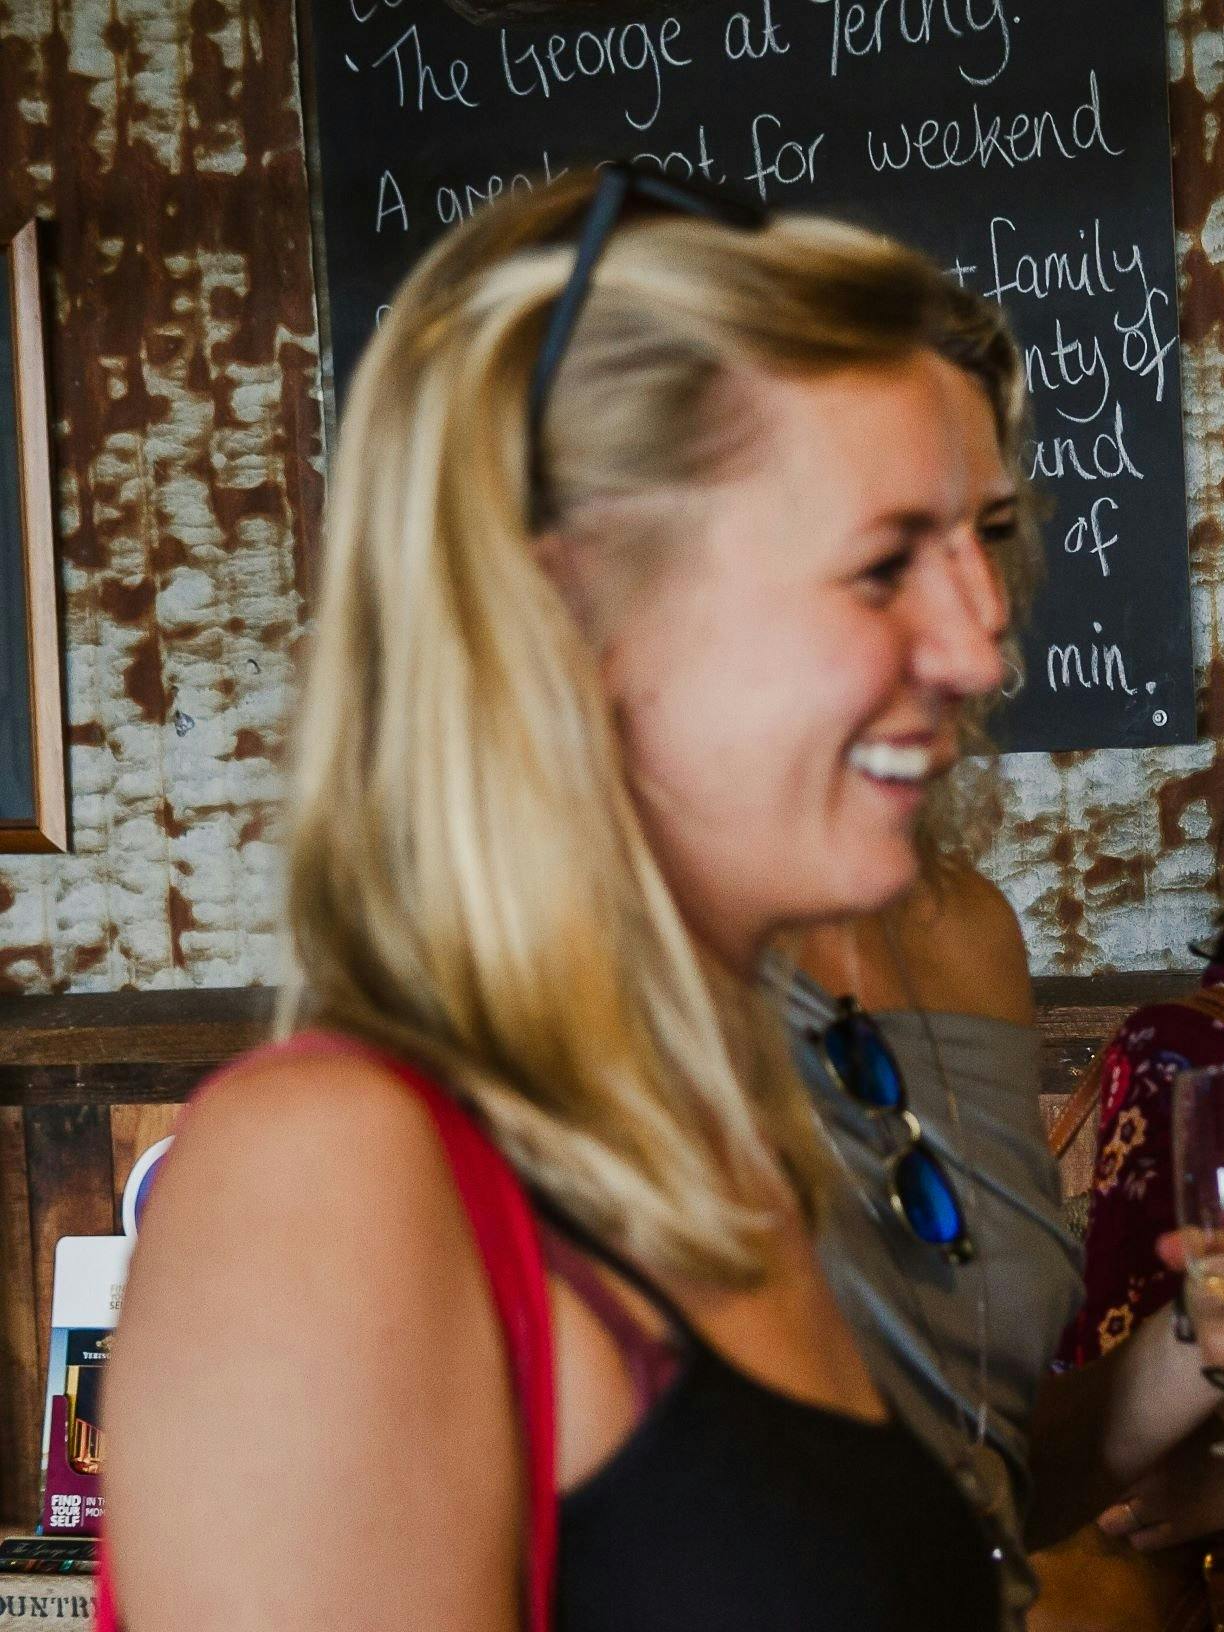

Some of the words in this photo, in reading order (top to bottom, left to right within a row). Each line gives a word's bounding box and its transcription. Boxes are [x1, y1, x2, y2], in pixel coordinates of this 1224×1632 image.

[501, 18, 692, 130] George
[725, 0, 790, 59] at
[376, 170, 408, 232] A
[744, 113, 824, 201] for
[867, 69, 1126, 171] weekend
[983, 217, 1150, 332] family
[1123, 287, 1180, 402] of
[1065, 497, 1119, 577] of
[1046, 621, 1157, 695] min.
[50, 1515, 81, 1528] SELF
[51, 1494, 82, 1506] FIND
[51, 1505, 81, 1516] YOUR
